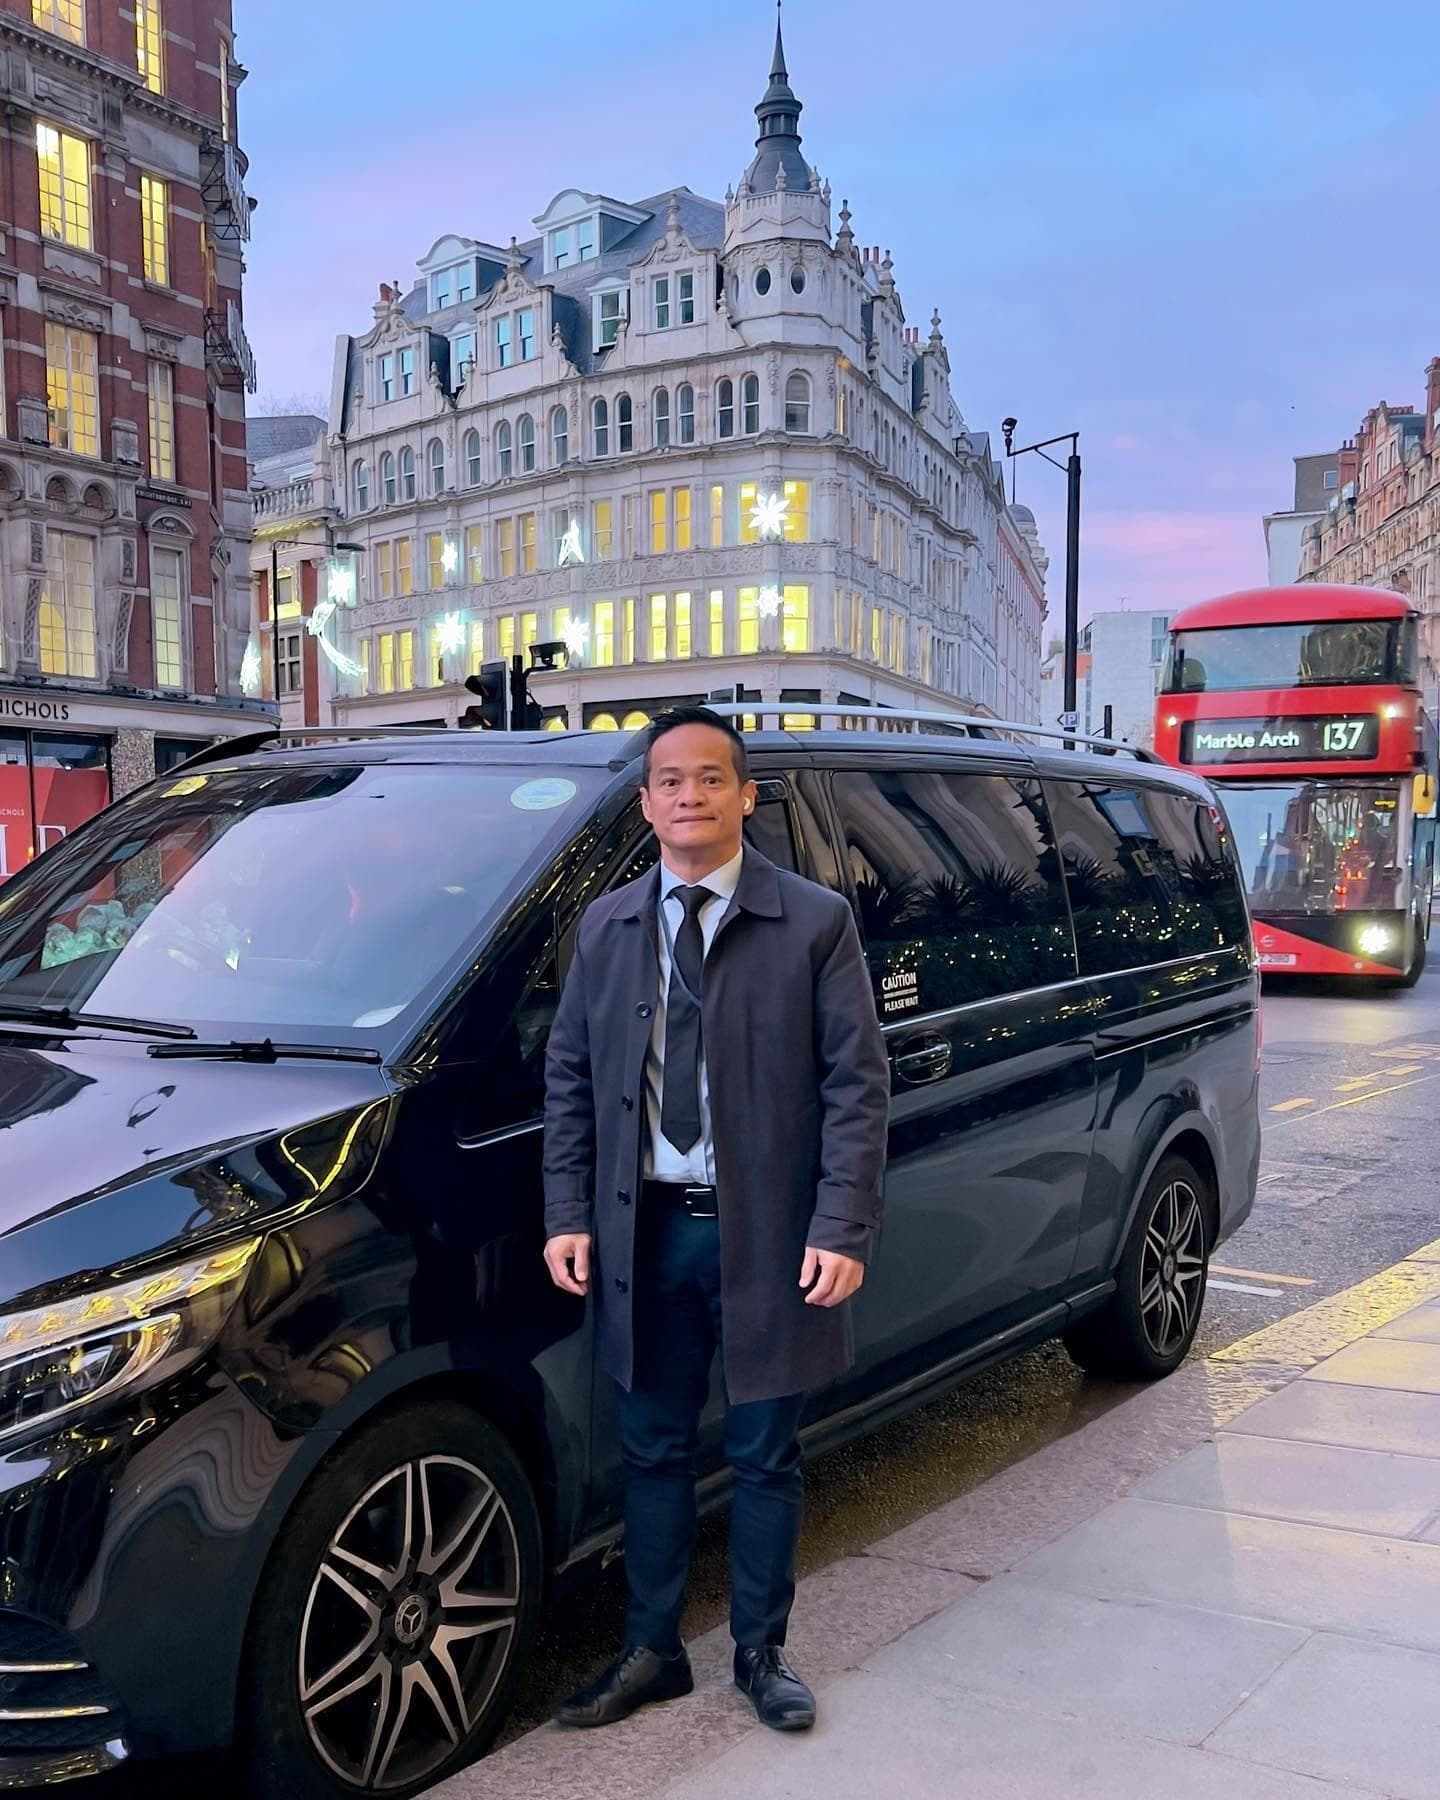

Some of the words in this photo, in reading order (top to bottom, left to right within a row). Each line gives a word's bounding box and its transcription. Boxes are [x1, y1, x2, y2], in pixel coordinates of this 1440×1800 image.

[1067, 714, 1076, 725] P
[1196, 733, 1256, 749] Marble
[1260, 731, 1300, 748] Arch
[1323, 721, 1365, 751] 137
[882, 971, 917, 991] CAUTION
[884, 999, 905, 1012] PLEASE
